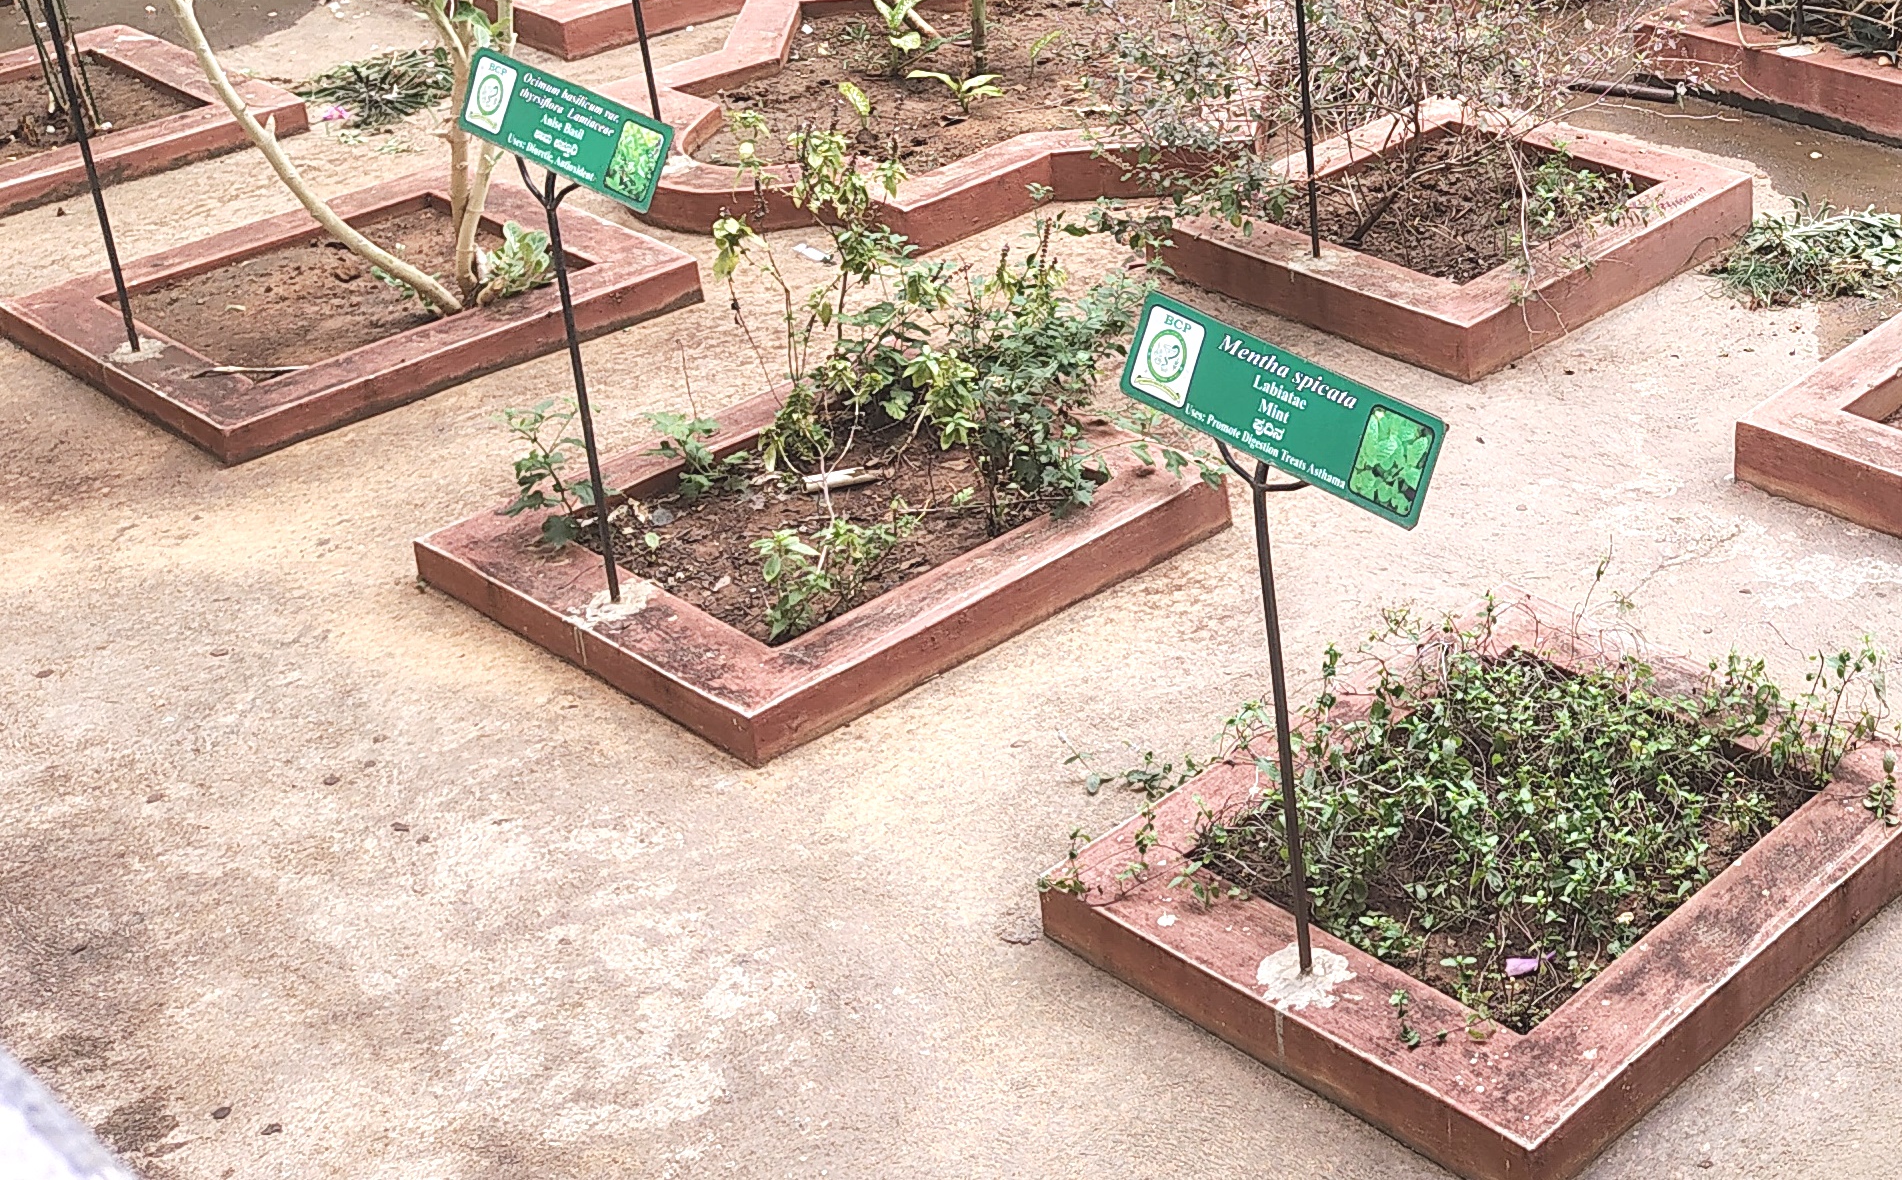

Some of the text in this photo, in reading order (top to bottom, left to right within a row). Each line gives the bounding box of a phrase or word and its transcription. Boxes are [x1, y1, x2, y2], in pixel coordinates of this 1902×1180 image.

[523, 72, 561, 96] Ocimum
[1163, 314, 1192, 333] BCP
[1218, 334, 1357, 409] Mentha spicata
[1252, 374, 1307, 410] Labiatae
[1258, 398, 1289, 424] Mint
[1185, 402, 1206, 422] Uses:
[1206, 413, 1241, 439] Promote
[1241, 430, 1279, 458] Digestion
[1280, 448, 1307, 471] Treats
